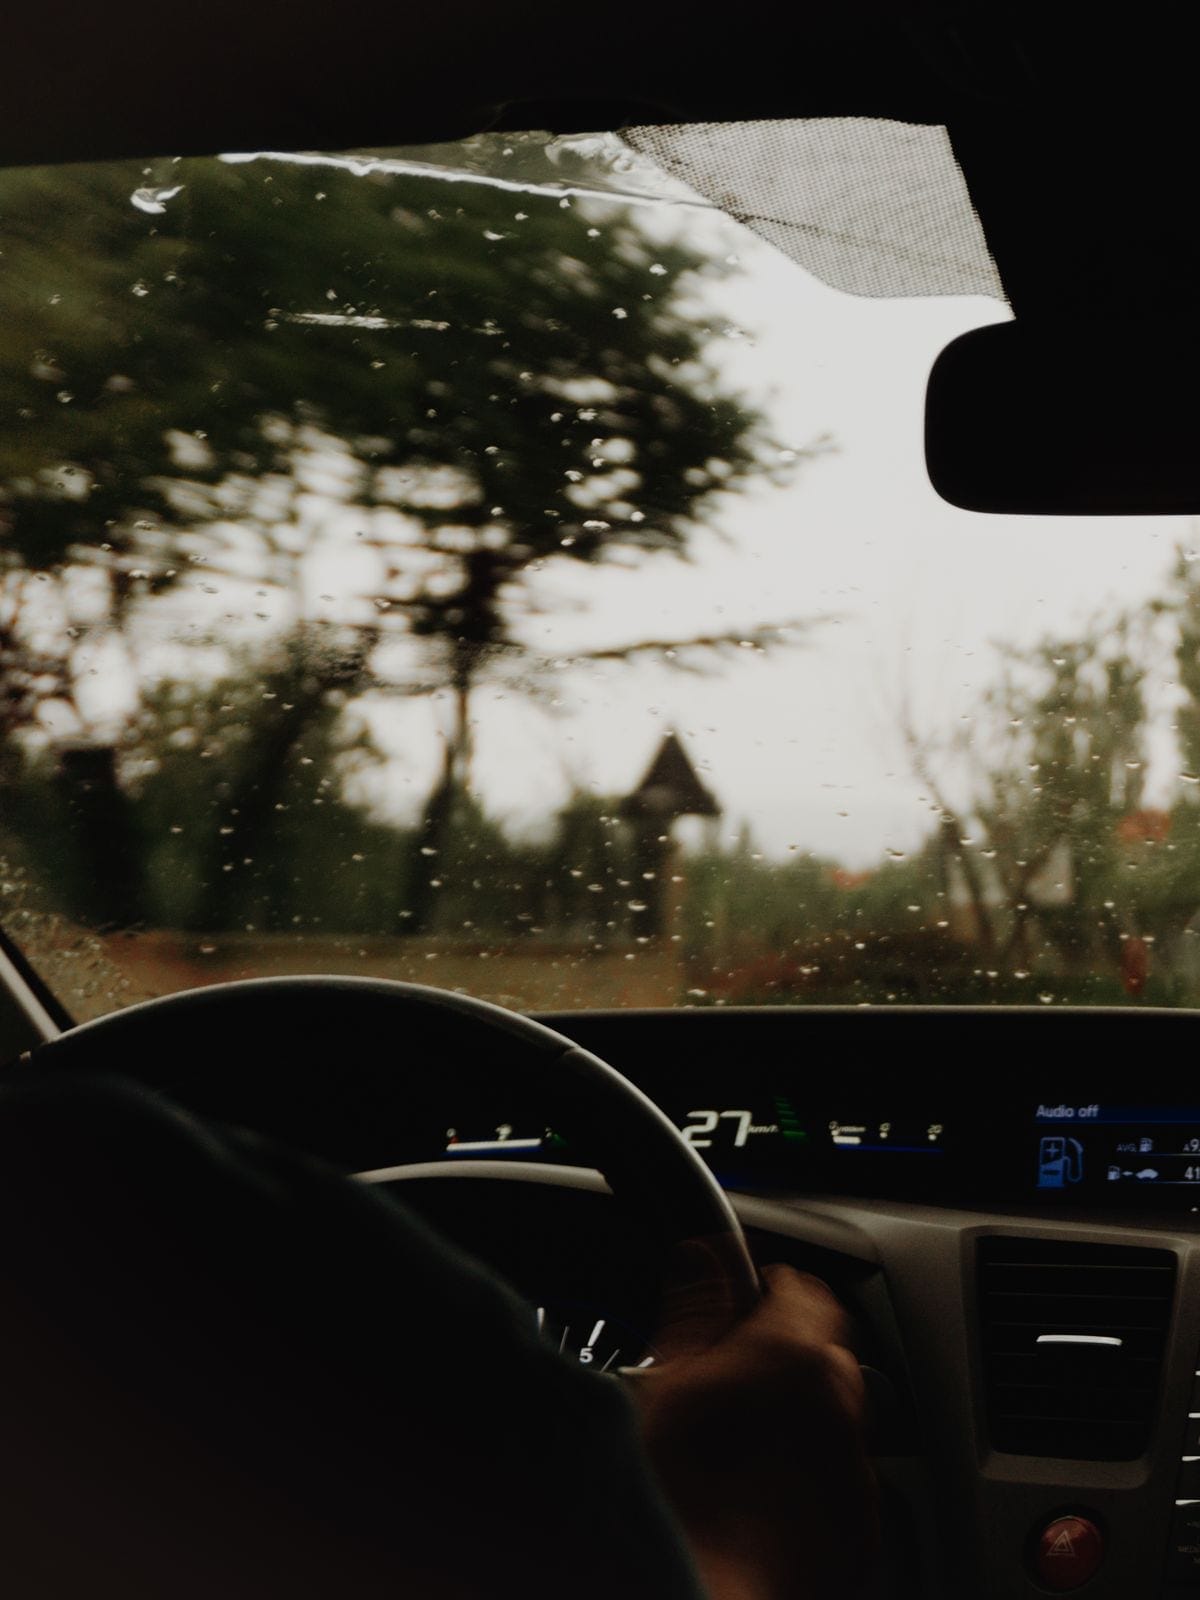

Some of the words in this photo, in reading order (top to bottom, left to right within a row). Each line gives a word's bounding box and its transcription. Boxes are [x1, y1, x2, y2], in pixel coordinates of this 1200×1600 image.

[1035, 1105, 1075, 1118] Audio
[1078, 1105, 1100, 1118] off
[682, 1110, 752, 1147] 27
[579, 1347, 594, 1363] 5
